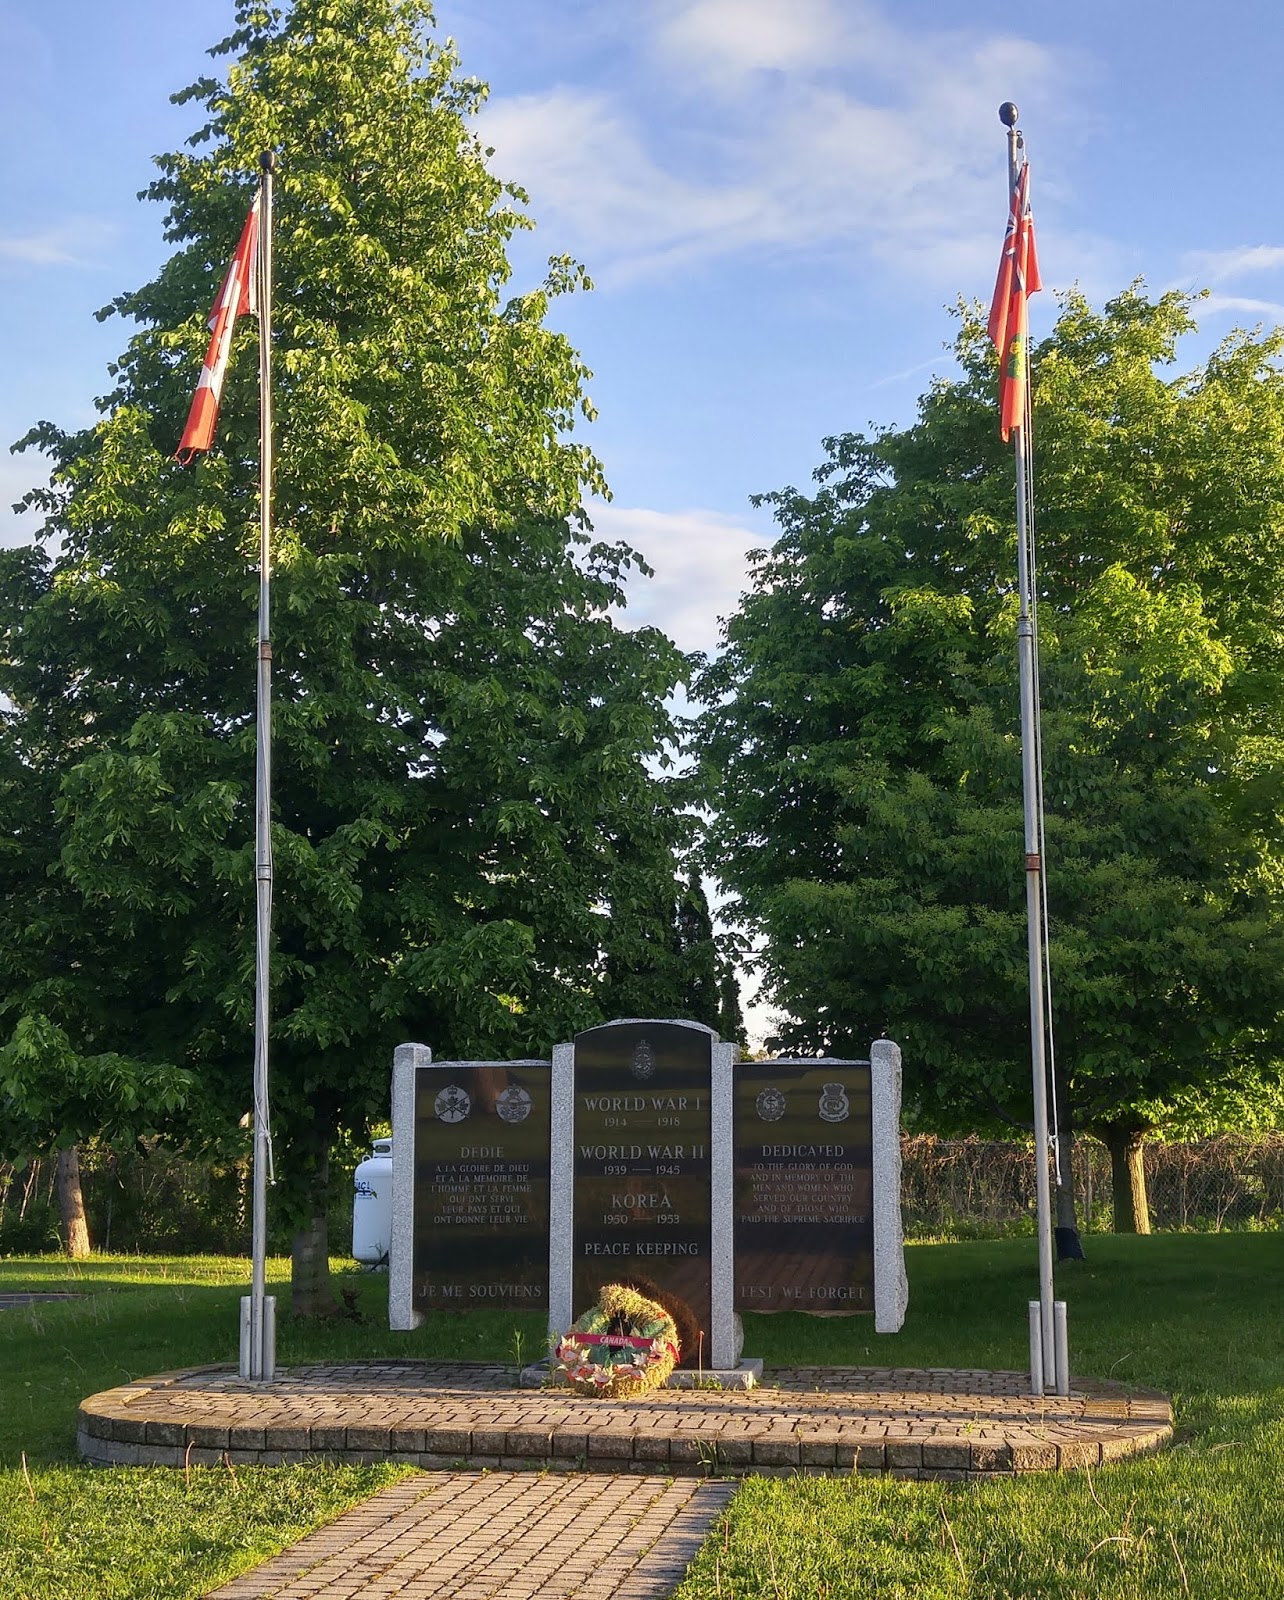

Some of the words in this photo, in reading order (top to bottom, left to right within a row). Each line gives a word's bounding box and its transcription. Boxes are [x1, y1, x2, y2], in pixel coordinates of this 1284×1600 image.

[584, 1097, 646, 1112] WORLD
[651, 1097, 688, 1112] WAR
[696, 1097, 700, 1112] I
[604, 1117, 627, 1127] 1914
[657, 1117, 681, 1127] 1918
[461, 1146, 505, 1159] DEDIE
[580, 1145, 642, 1160] WORLD
[647, 1145, 685, 1160] WAR
[692, 1145, 704, 1160] II
[762, 1145, 844, 1157] DEDICATED
[435, 1164, 442, 1173] A
[459, 1164, 491, 1173] GLOIRE
[494, 1164, 506, 1173] DE
[509, 1164, 529, 1173] DIEU
[604, 1165, 627, 1175] 1939
[656, 1165, 681, 1175] 1945
[752, 1163, 764, 1171] TO
[767, 1163, 784, 1171] THE
[788, 1163, 816, 1171] GLORY
[819, 1163, 831, 1171] OF
[834, 1163, 853, 1171] GOD
[435, 1175, 446, 1183] ET
[449, 1175, 455, 1183] A
[459, 1175, 470, 1183] LA
[473, 1175, 513, 1183] MEMOIRE
[517, 1175, 528, 1183] DE
[750, 1174, 768, 1182] AND
[772, 1174, 781, 1182] IN
[784, 1174, 821, 1182] MEMORY
[824, 1174, 835, 1182] OF
[840, 1174, 855, 1182] THE
[474, 1185, 484, 1193] ET
[488, 1185, 499, 1193] LA
[502, 1185, 532, 1193] FEMME
[752, 1184, 771, 1192] MEN
[775, 1184, 794, 1192] AND
[798, 1184, 829, 1192] WOMEN
[833, 1184, 853, 1192] WHO
[449, 1195, 465, 1203] QUI
[469, 1195, 486, 1203] ONT
[490, 1195, 514, 1203] SERVI
[612, 1194, 672, 1208] KOREA
[753, 1194, 786, 1203] SERVED
[789, 1194, 808, 1203] OUR
[811, 1194, 852, 1203] COUNTRY
[442, 1205, 464, 1214] LEUR
[468, 1205, 488, 1214] PAYS
[491, 1205, 501, 1214] ET
[504, 1205, 520, 1214] QUI
[758, 1205, 776, 1213] AND
[780, 1205, 792, 1213] OF
[797, 1205, 825, 1213] THOSE
[829, 1205, 849, 1213] WHO
[433, 1215, 452, 1224] ONT
[456, 1215, 485, 1224] DONNE
[490, 1215, 511, 1224] LEUR
[514, 1215, 529, 1224] VIE
[603, 1215, 628, 1224] 1950
[657, 1215, 680, 1224] 1953
[742, 1215, 761, 1223] PAID
[763, 1215, 780, 1223] THE
[783, 1215, 821, 1223] SUPREME
[824, 1215, 865, 1223] SACRIFICE
[585, 1243, 631, 1255] PEACE
[636, 1243, 699, 1255] KEEPING
[419, 1285, 437, 1297] JE
[442, 1285, 462, 1297] ME
[469, 1285, 542, 1297] SOUVIENS
[741, 1286, 773, 1299] LEST
[782, 1286, 803, 1299] WE
[809, 1286, 866, 1299] FORGET
[600, 1336, 628, 1345] CANADA
